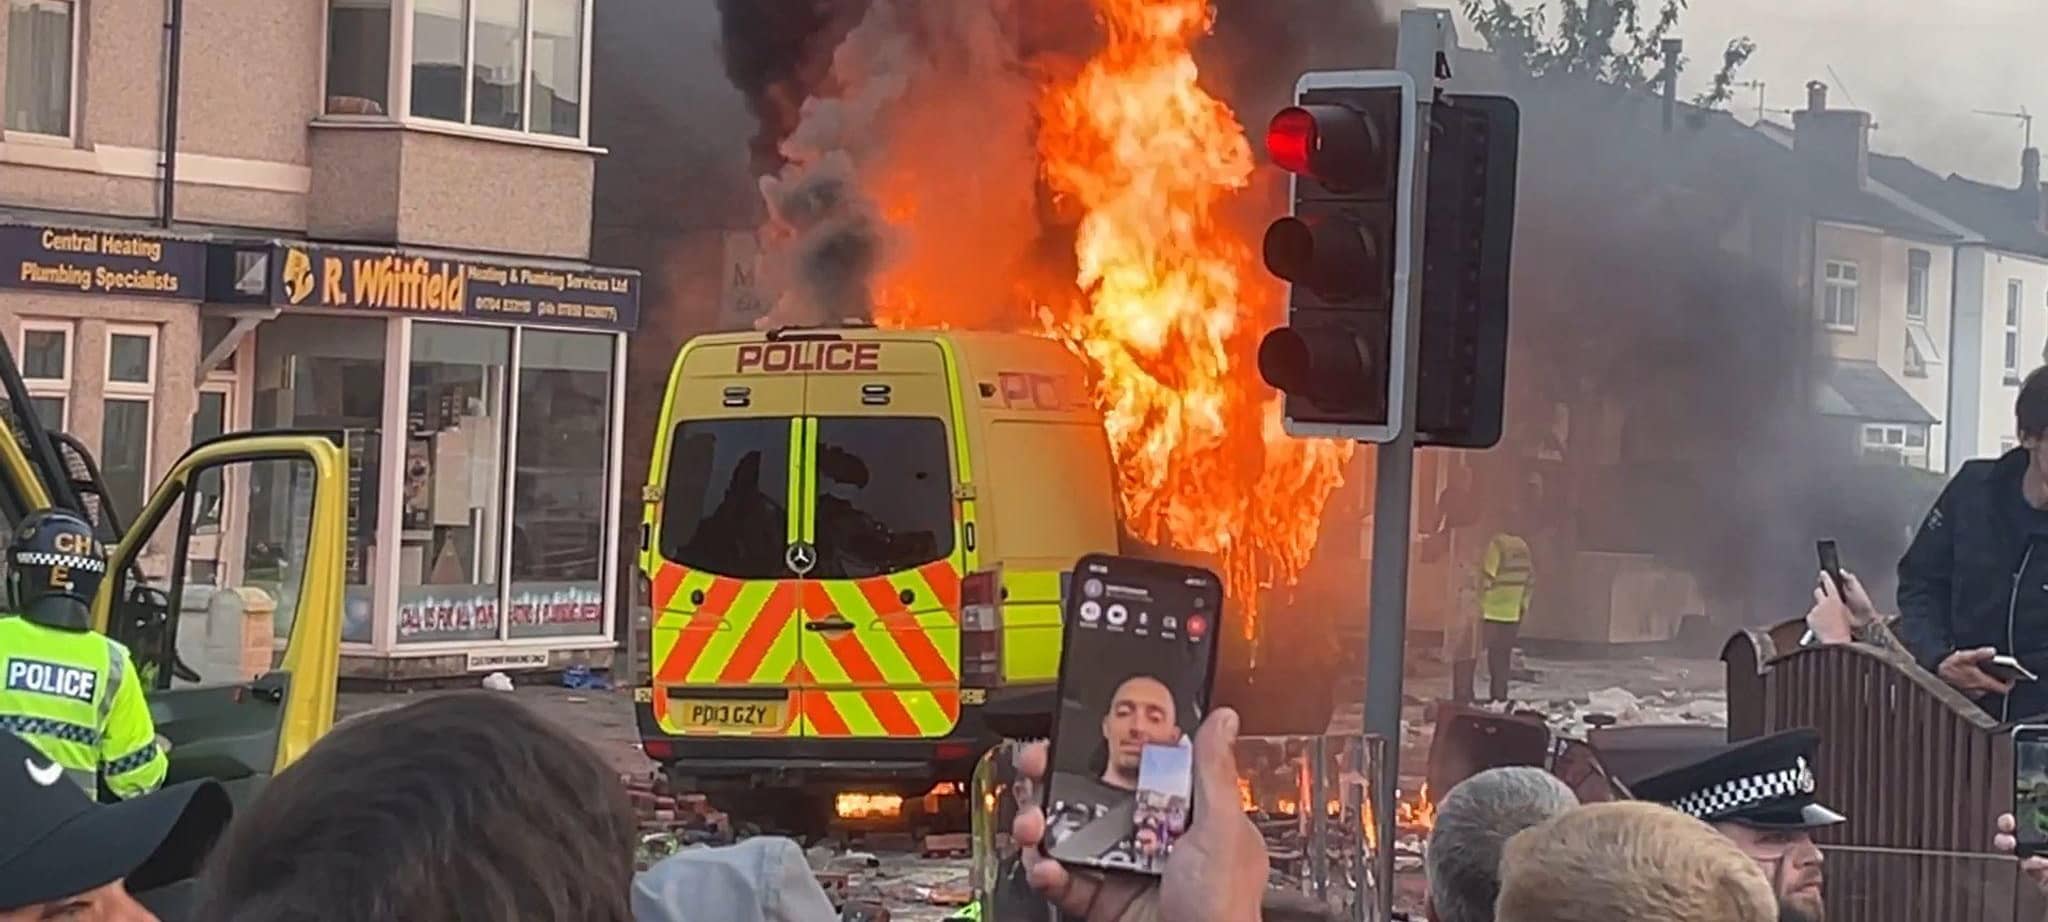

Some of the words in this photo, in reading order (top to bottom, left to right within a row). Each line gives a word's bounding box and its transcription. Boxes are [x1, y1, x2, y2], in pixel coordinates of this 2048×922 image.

[42, 230, 97, 250] Central
[102, 235, 162, 261] Heating
[21, 262, 92, 290] Plumbing
[95, 266, 178, 292] Specialists
[323, 257, 347, 305] R.
[354, 255, 466, 312] Whitfield
[510, 268, 519, 283] &
[567, 273, 609, 292] Services
[611, 277, 628, 293] Ltd
[737, 343, 881, 373] POLICE
[54, 532, 92, 555] CH
[50, 568, 69, 588] E
[9, 661, 95, 700] POLICE
[733, 703, 768, 725] GZY
